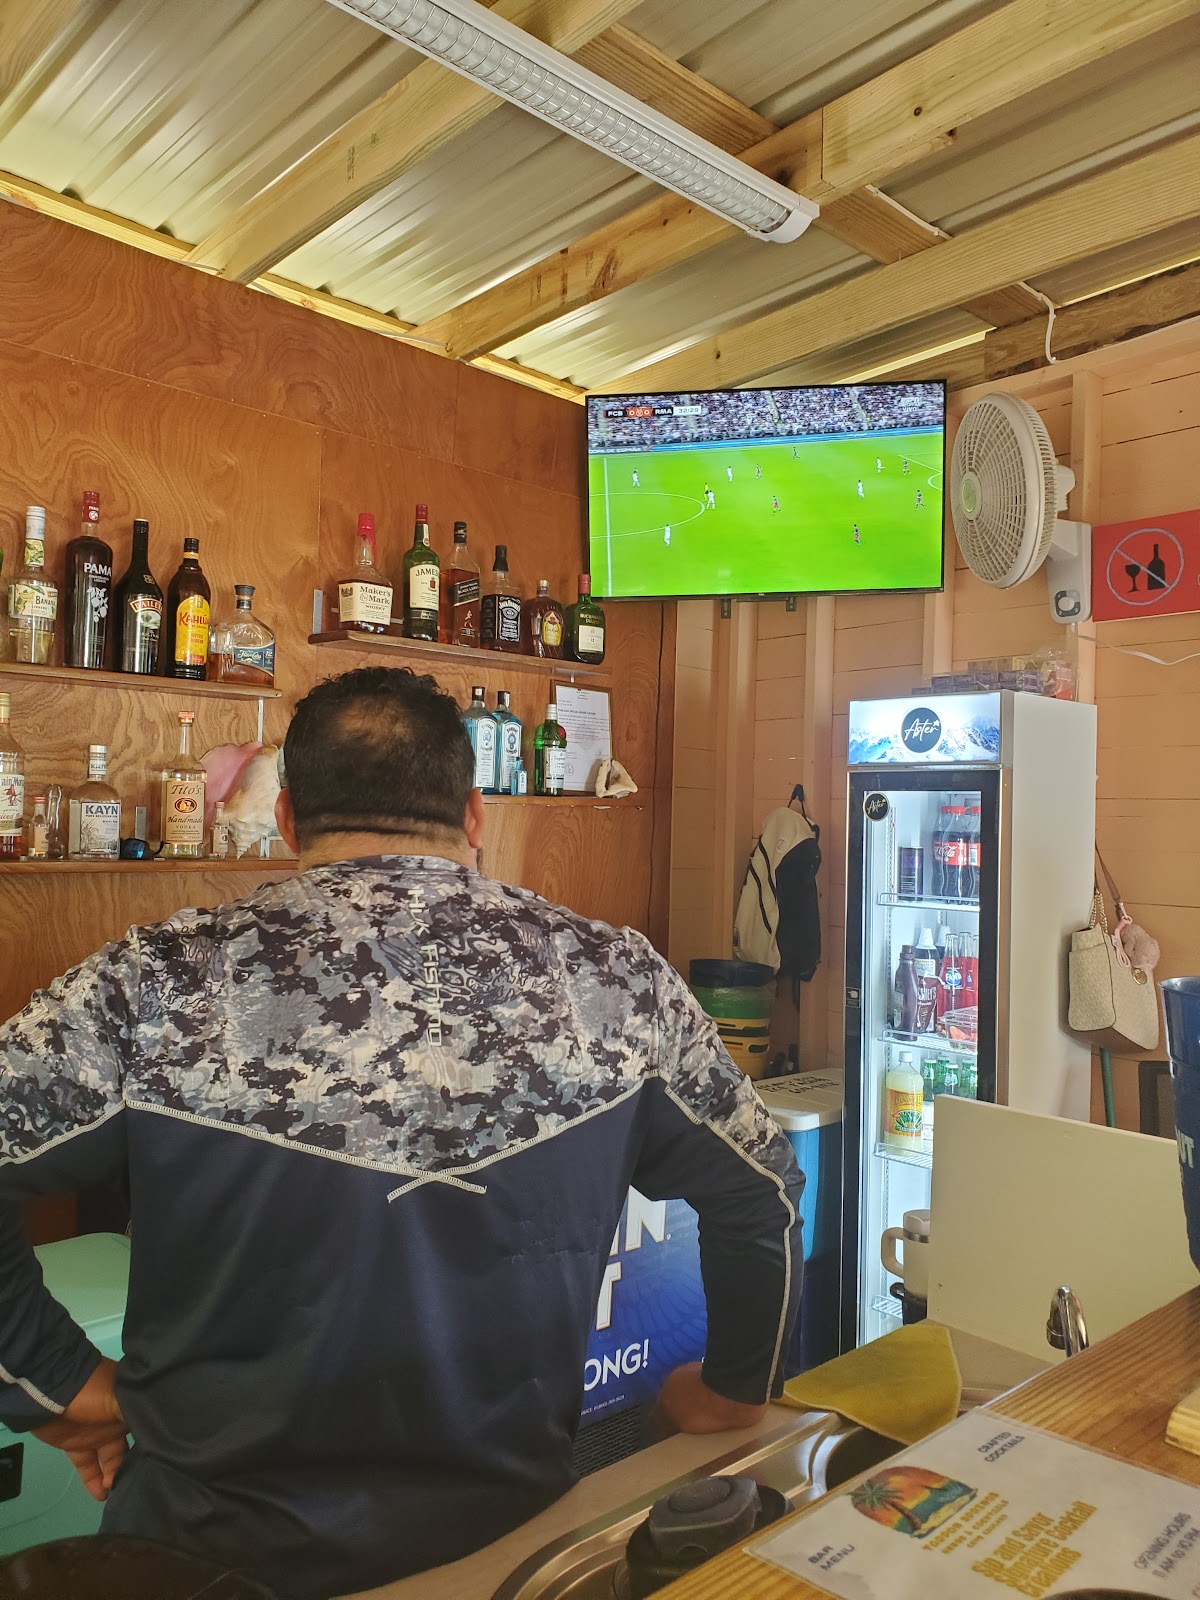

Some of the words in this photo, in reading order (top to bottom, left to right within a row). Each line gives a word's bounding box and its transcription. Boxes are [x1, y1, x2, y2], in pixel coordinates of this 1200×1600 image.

[83, 562, 112, 577] PAMA
[359, 585, 391, 598] Maker's
[368, 594, 390, 605] Mark
[903, 718, 939, 741] Aster
[171, 784, 201, 795] Tito's
[85, 805, 118, 815] KAYN
[977, 1431, 1011, 1454] CRAFTED
[984, 1435, 1025, 1463] COCKTAILS
[993, 1537, 1026, 1562] and
[1133, 1533, 1171, 1571] OPENING
[1166, 1511, 1192, 1541] HOURS
[808, 1544, 835, 1565] BAR
[820, 1543, 856, 1572] MENU
